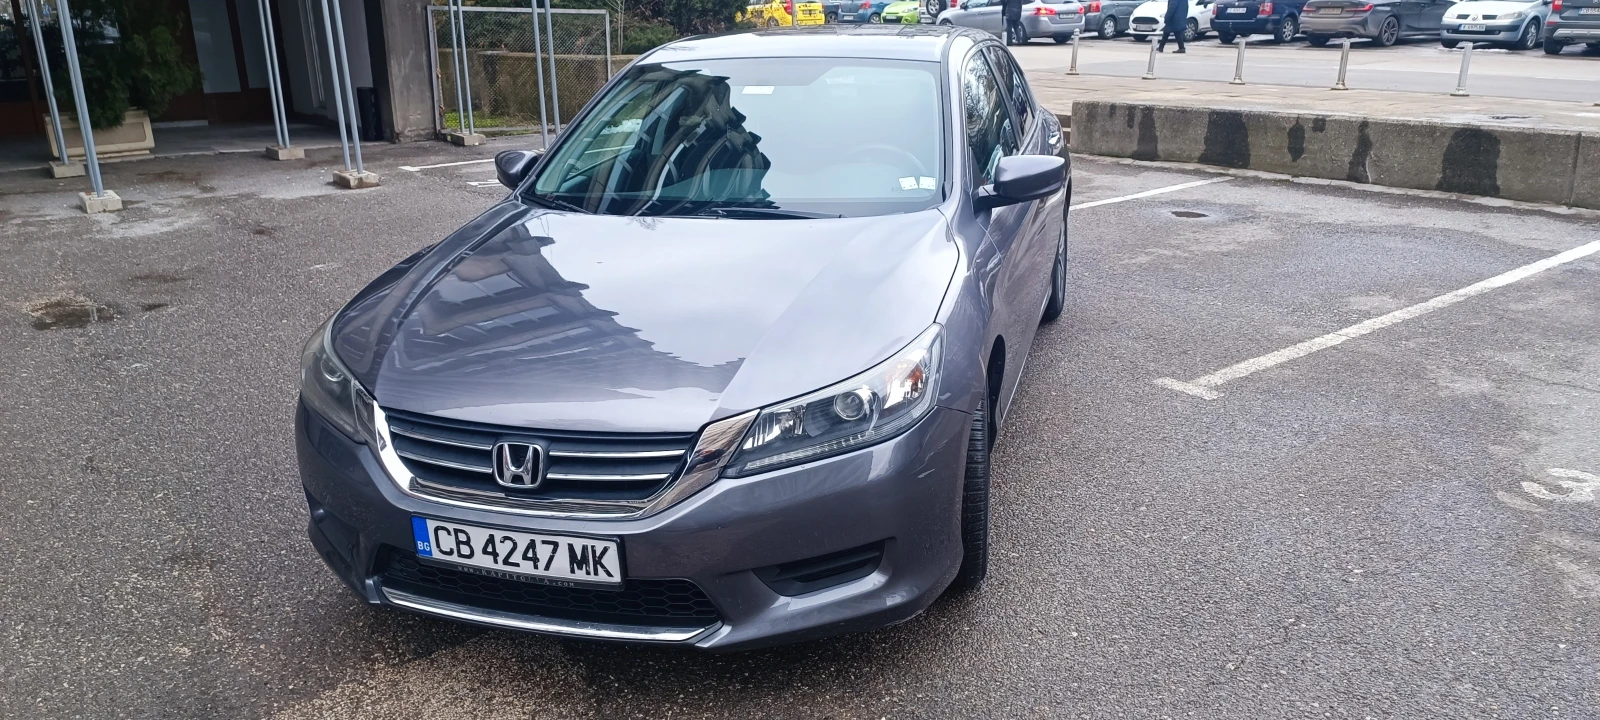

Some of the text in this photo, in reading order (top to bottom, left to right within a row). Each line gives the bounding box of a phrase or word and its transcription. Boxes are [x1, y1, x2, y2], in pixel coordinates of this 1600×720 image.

[417, 541, 431, 551] BG
[433, 525, 614, 578] CB 4247 MK
